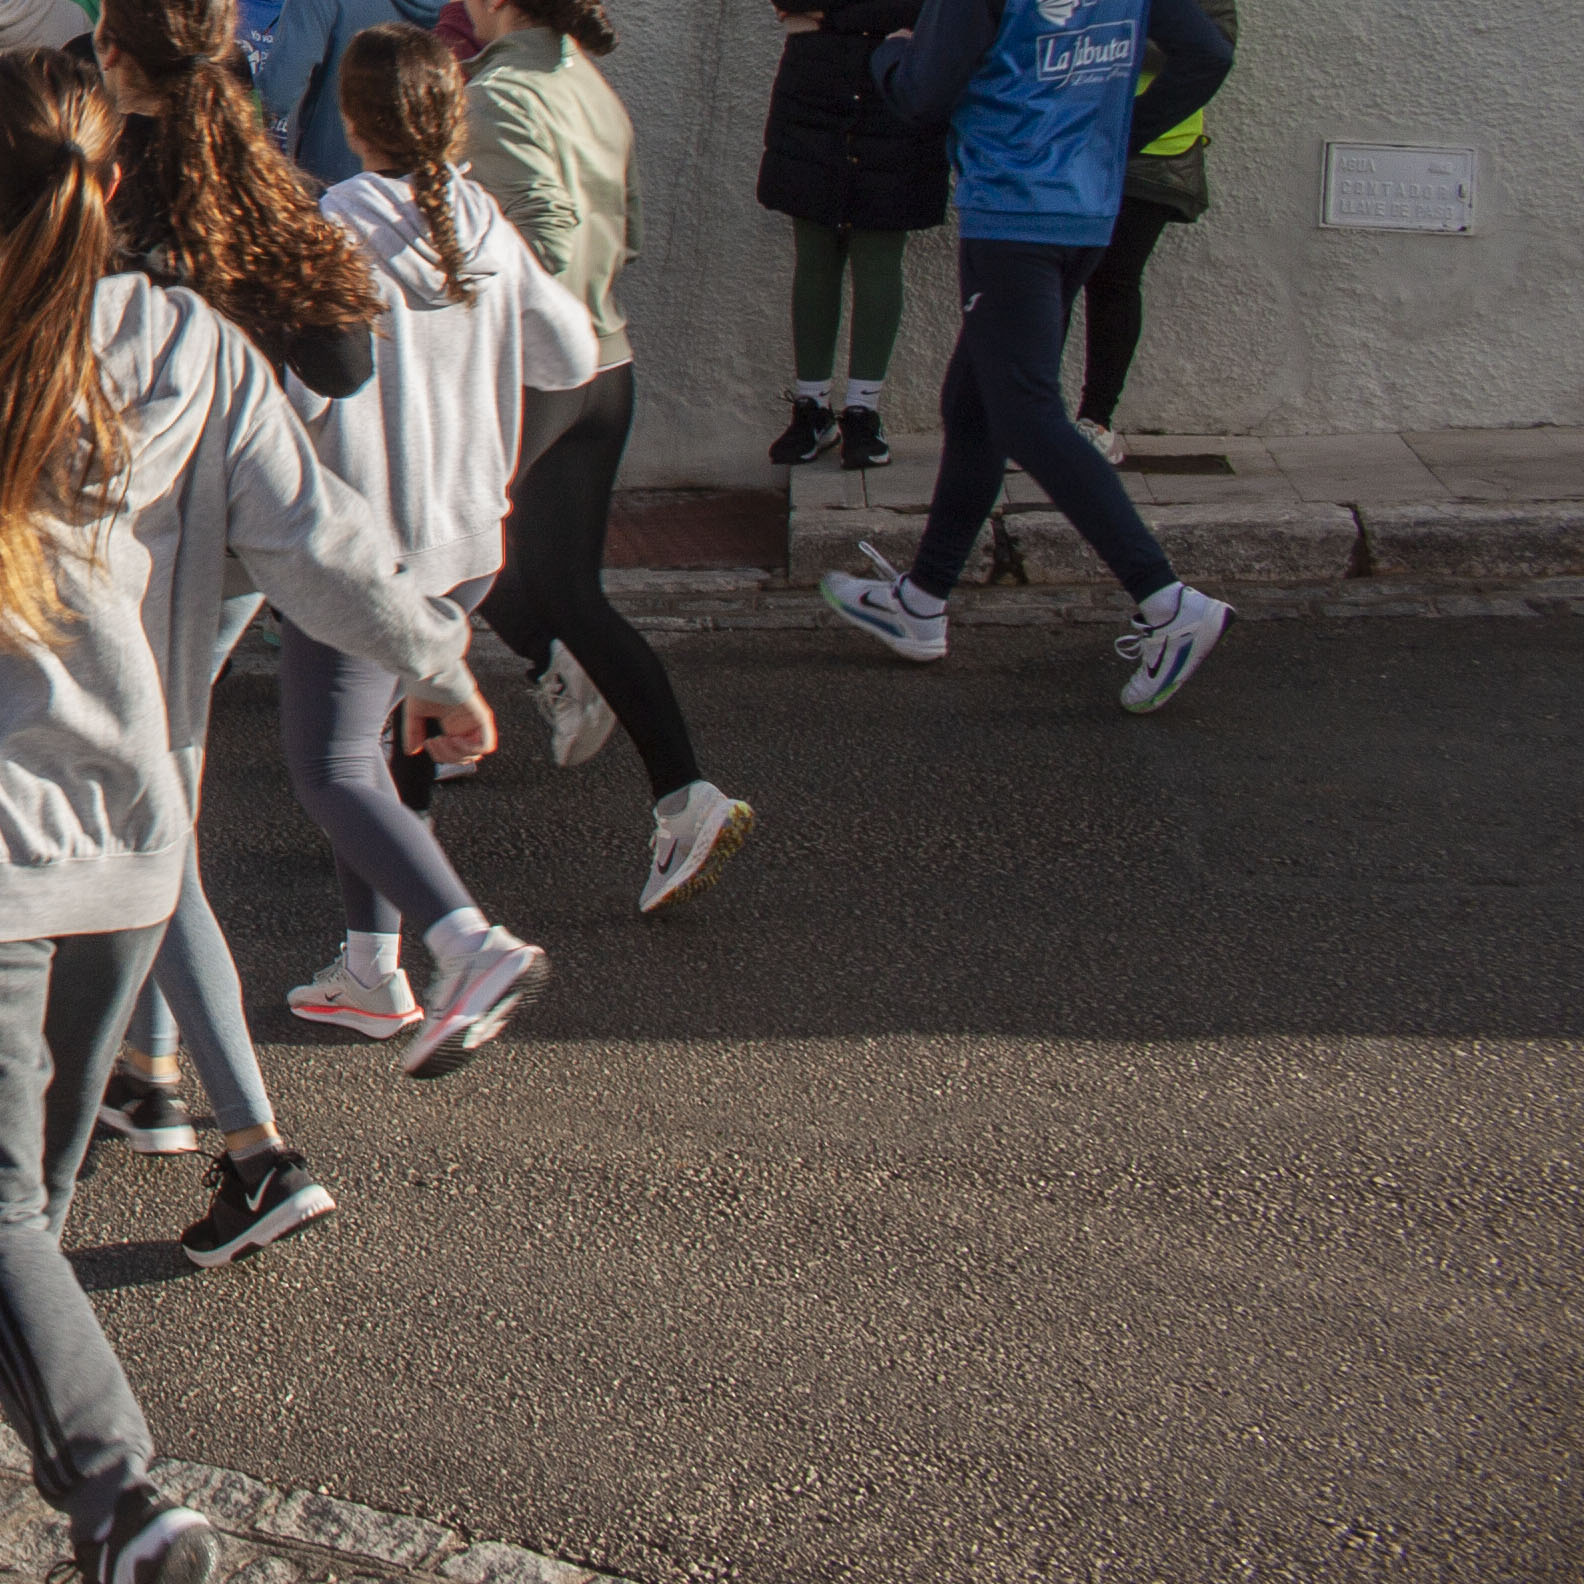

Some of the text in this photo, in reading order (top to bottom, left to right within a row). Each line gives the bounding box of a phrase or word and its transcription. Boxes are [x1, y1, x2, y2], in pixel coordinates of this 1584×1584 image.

[1042, 37, 1072, 72] La
[1339, 156, 1376, 173] AGUA
[1341, 179, 1450, 201] CONTADOR
[1340, 198, 1385, 216] LLAVE
[1391, 202, 1409, 217] DE
